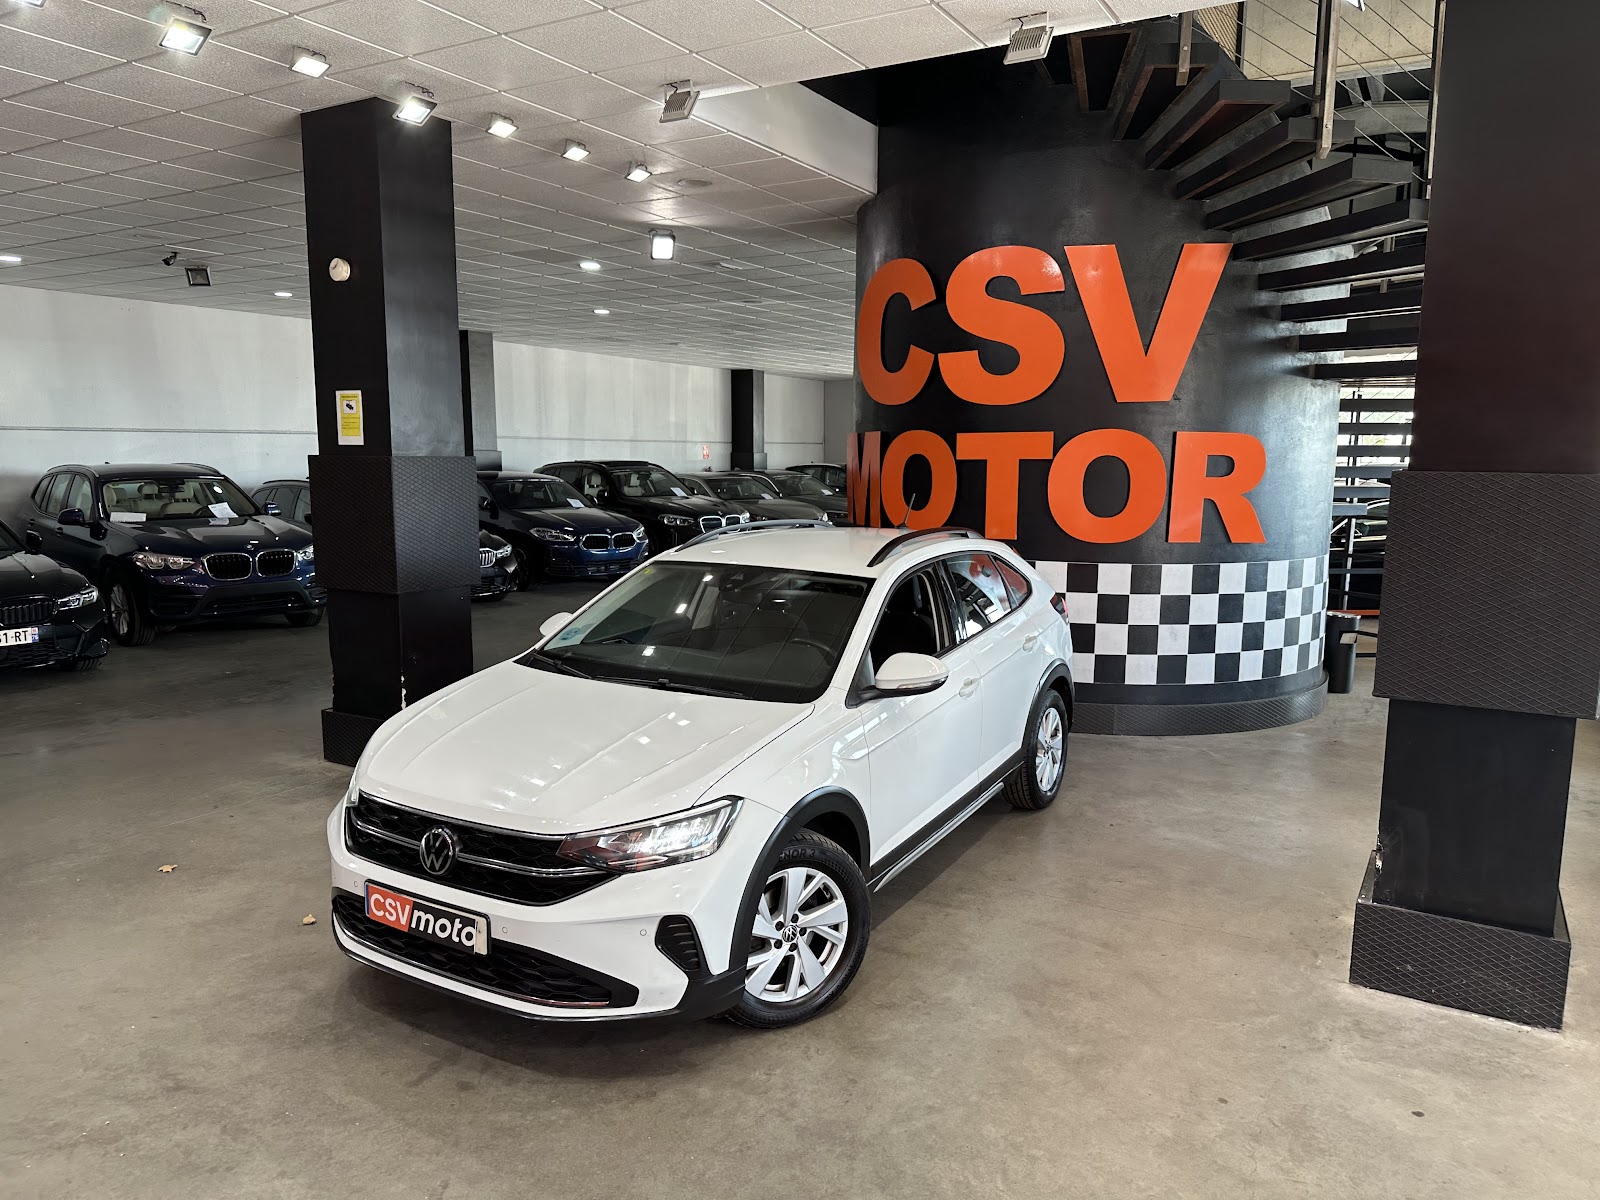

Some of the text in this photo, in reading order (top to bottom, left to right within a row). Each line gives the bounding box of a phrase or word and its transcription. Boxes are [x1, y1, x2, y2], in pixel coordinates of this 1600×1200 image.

[857, 243, 1234, 406] CSV
[846, 428, 1267, 544] MOTOR
[0, 630, 28, 644] 1-RT
